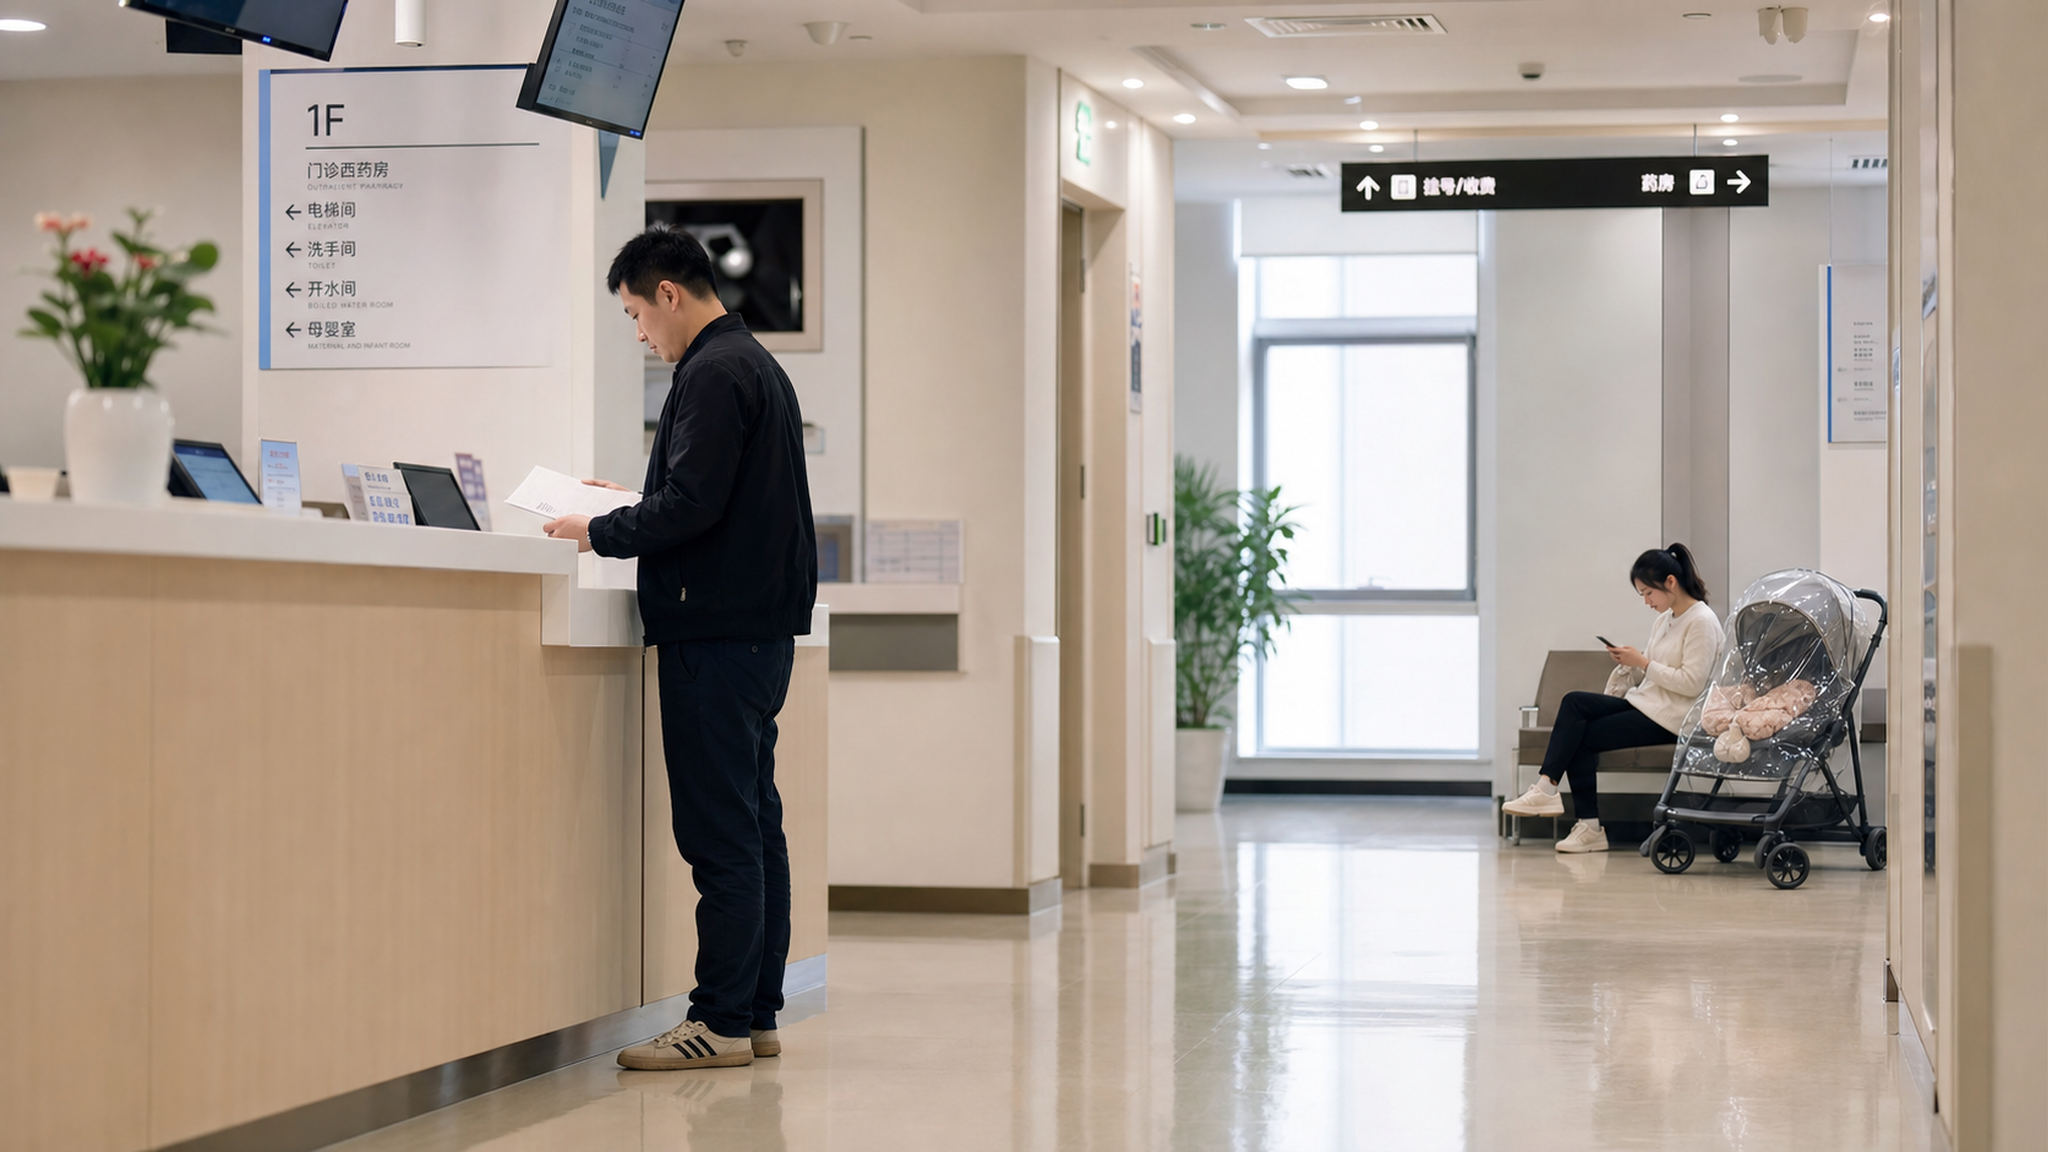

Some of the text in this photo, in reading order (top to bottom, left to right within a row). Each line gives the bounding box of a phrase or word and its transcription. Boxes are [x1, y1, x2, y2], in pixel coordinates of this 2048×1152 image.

[307, 103, 345, 137] 1F
[307, 161, 389, 179] 门诊西药房
[1641, 173, 1675, 193] 药房
[307, 201, 356, 218] 电梯间
[307, 240, 356, 257] 洗手间
[307, 280, 357, 297] 开水间
[307, 320, 356, 338] 母婴室
